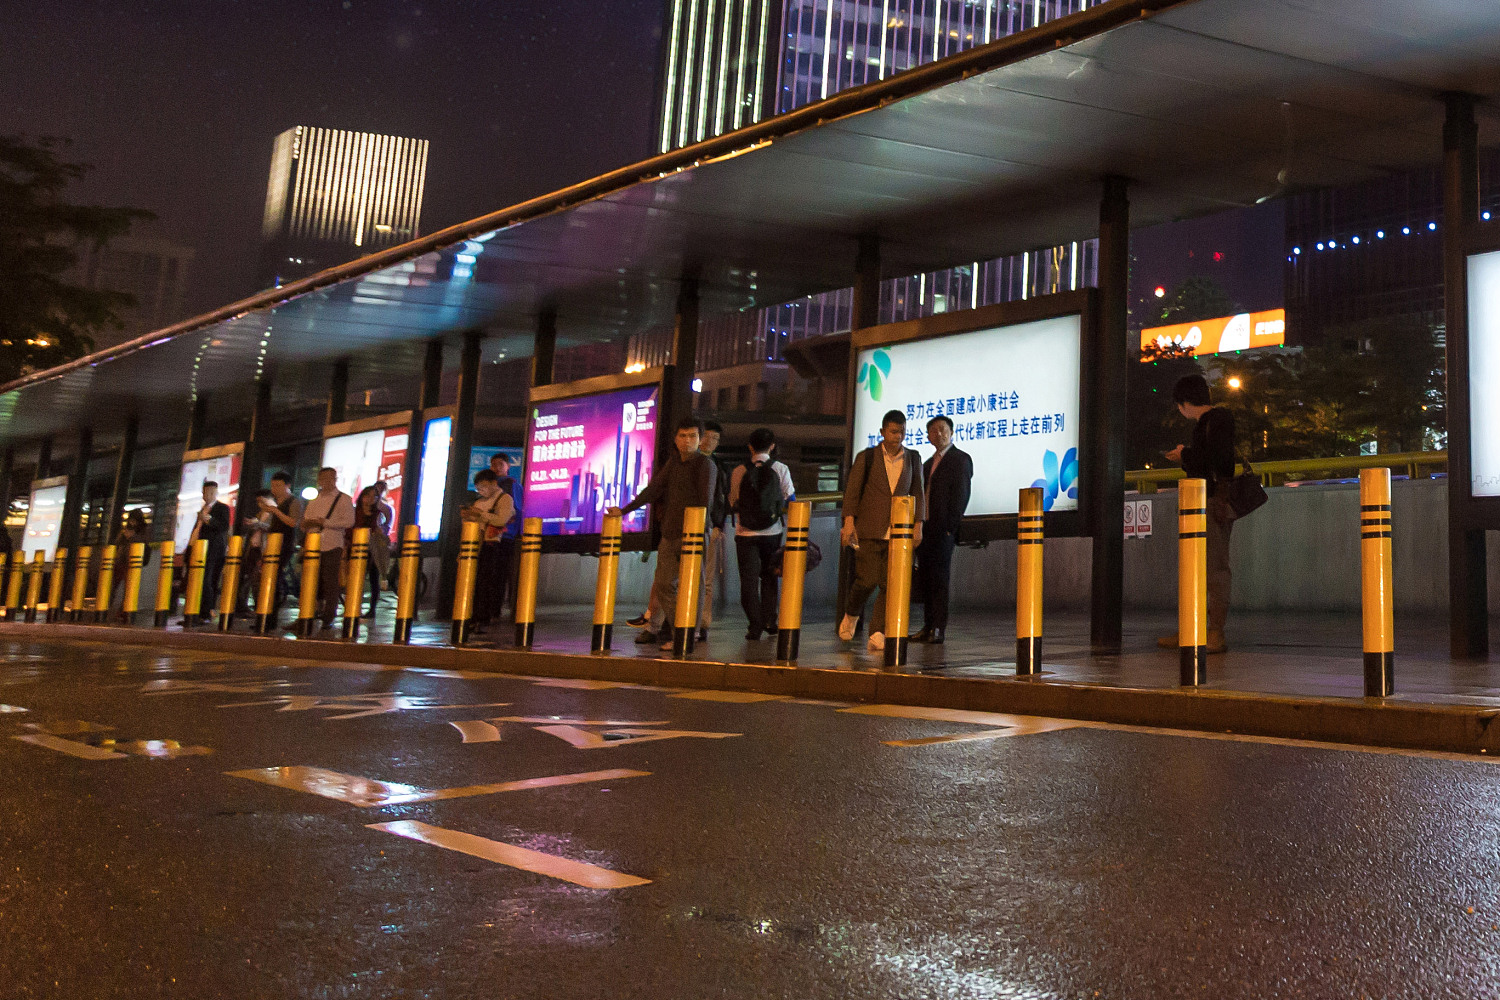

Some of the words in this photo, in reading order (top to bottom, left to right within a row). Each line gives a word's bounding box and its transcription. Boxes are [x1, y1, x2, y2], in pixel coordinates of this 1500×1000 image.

[906, 390, 1020, 421] 努力在全面建成小康社会
